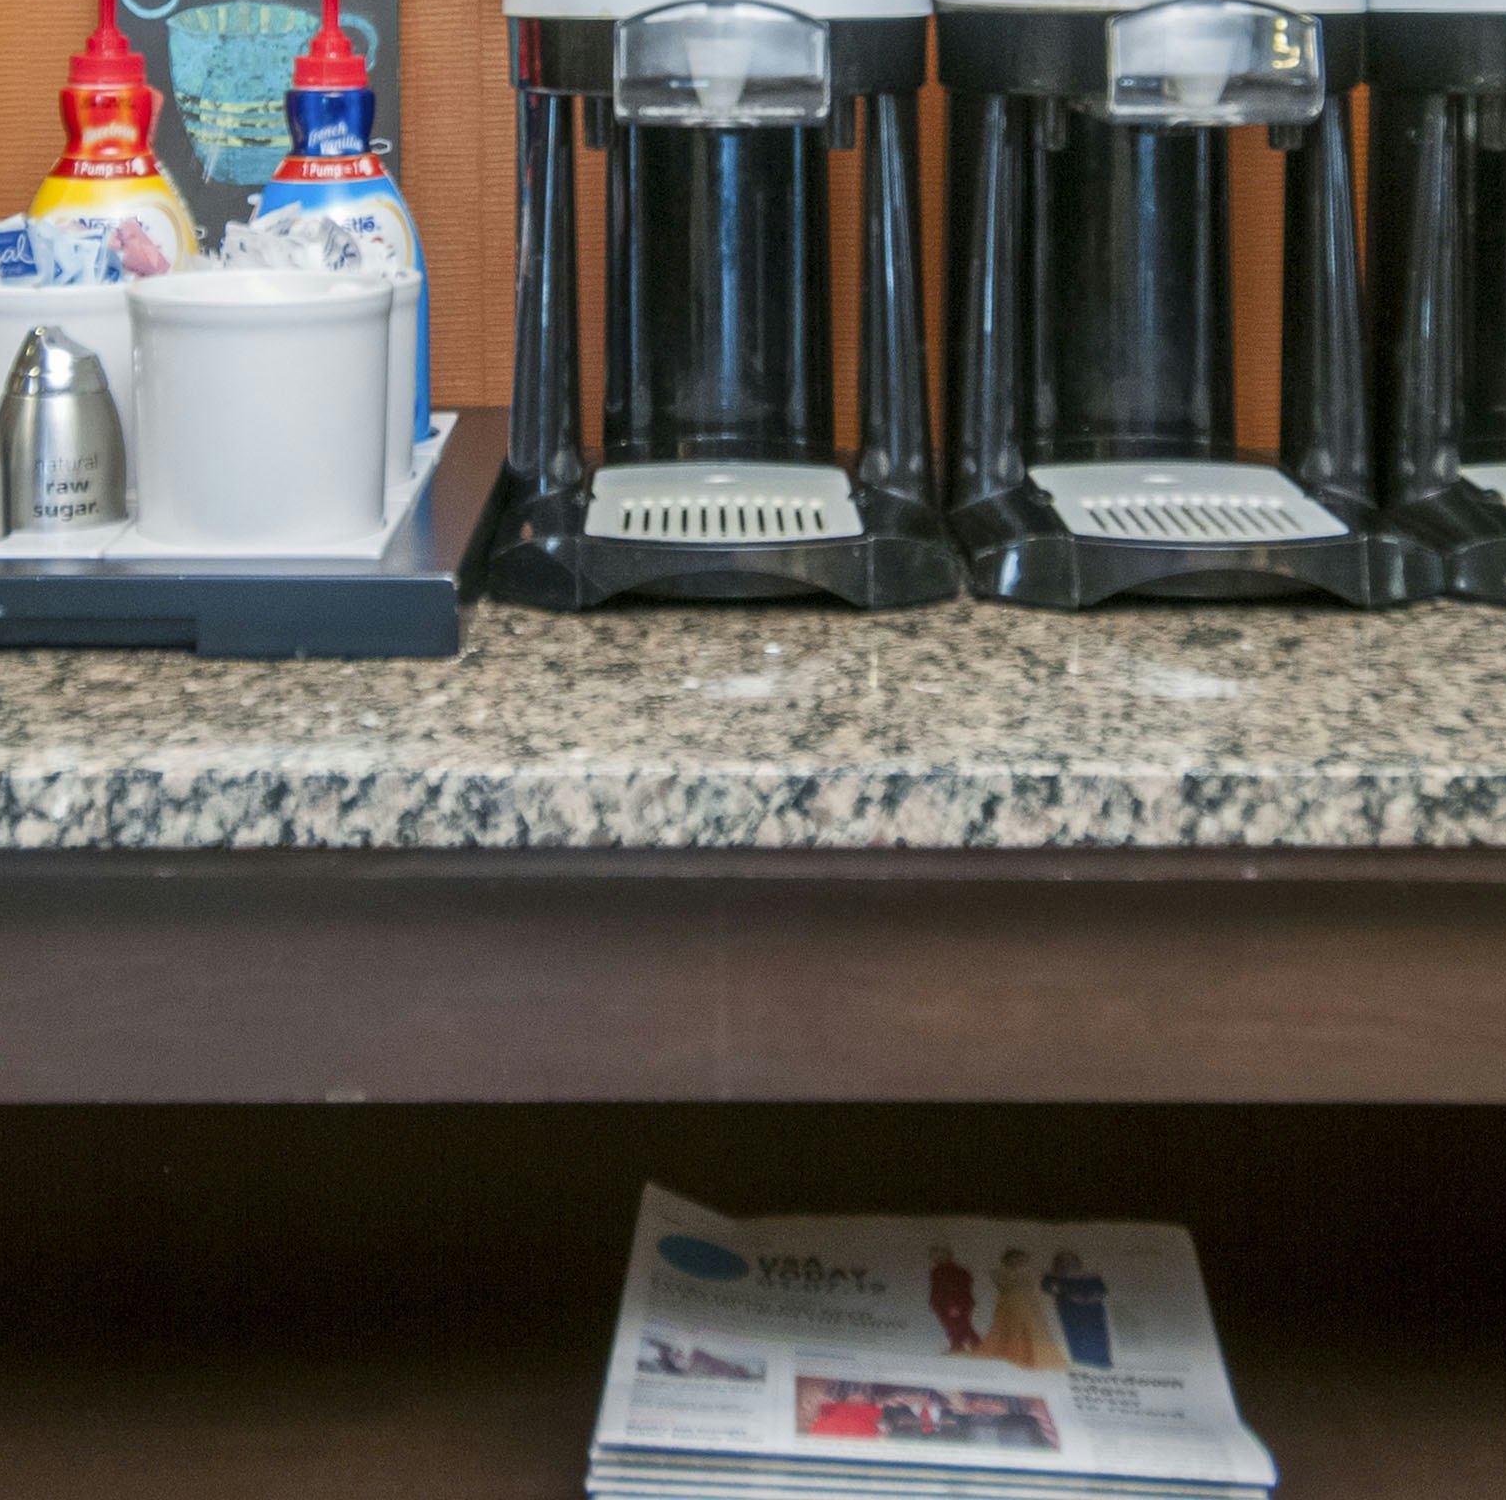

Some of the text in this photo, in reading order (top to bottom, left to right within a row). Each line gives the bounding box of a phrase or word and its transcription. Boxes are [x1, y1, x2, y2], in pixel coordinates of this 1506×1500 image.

[80, 160, 114, 178] Pump
[309, 161, 343, 179] Pump
[35, 454, 98, 473] natural
[46, 480, 90, 496] raw
[33, 500, 100, 522] sugar.
